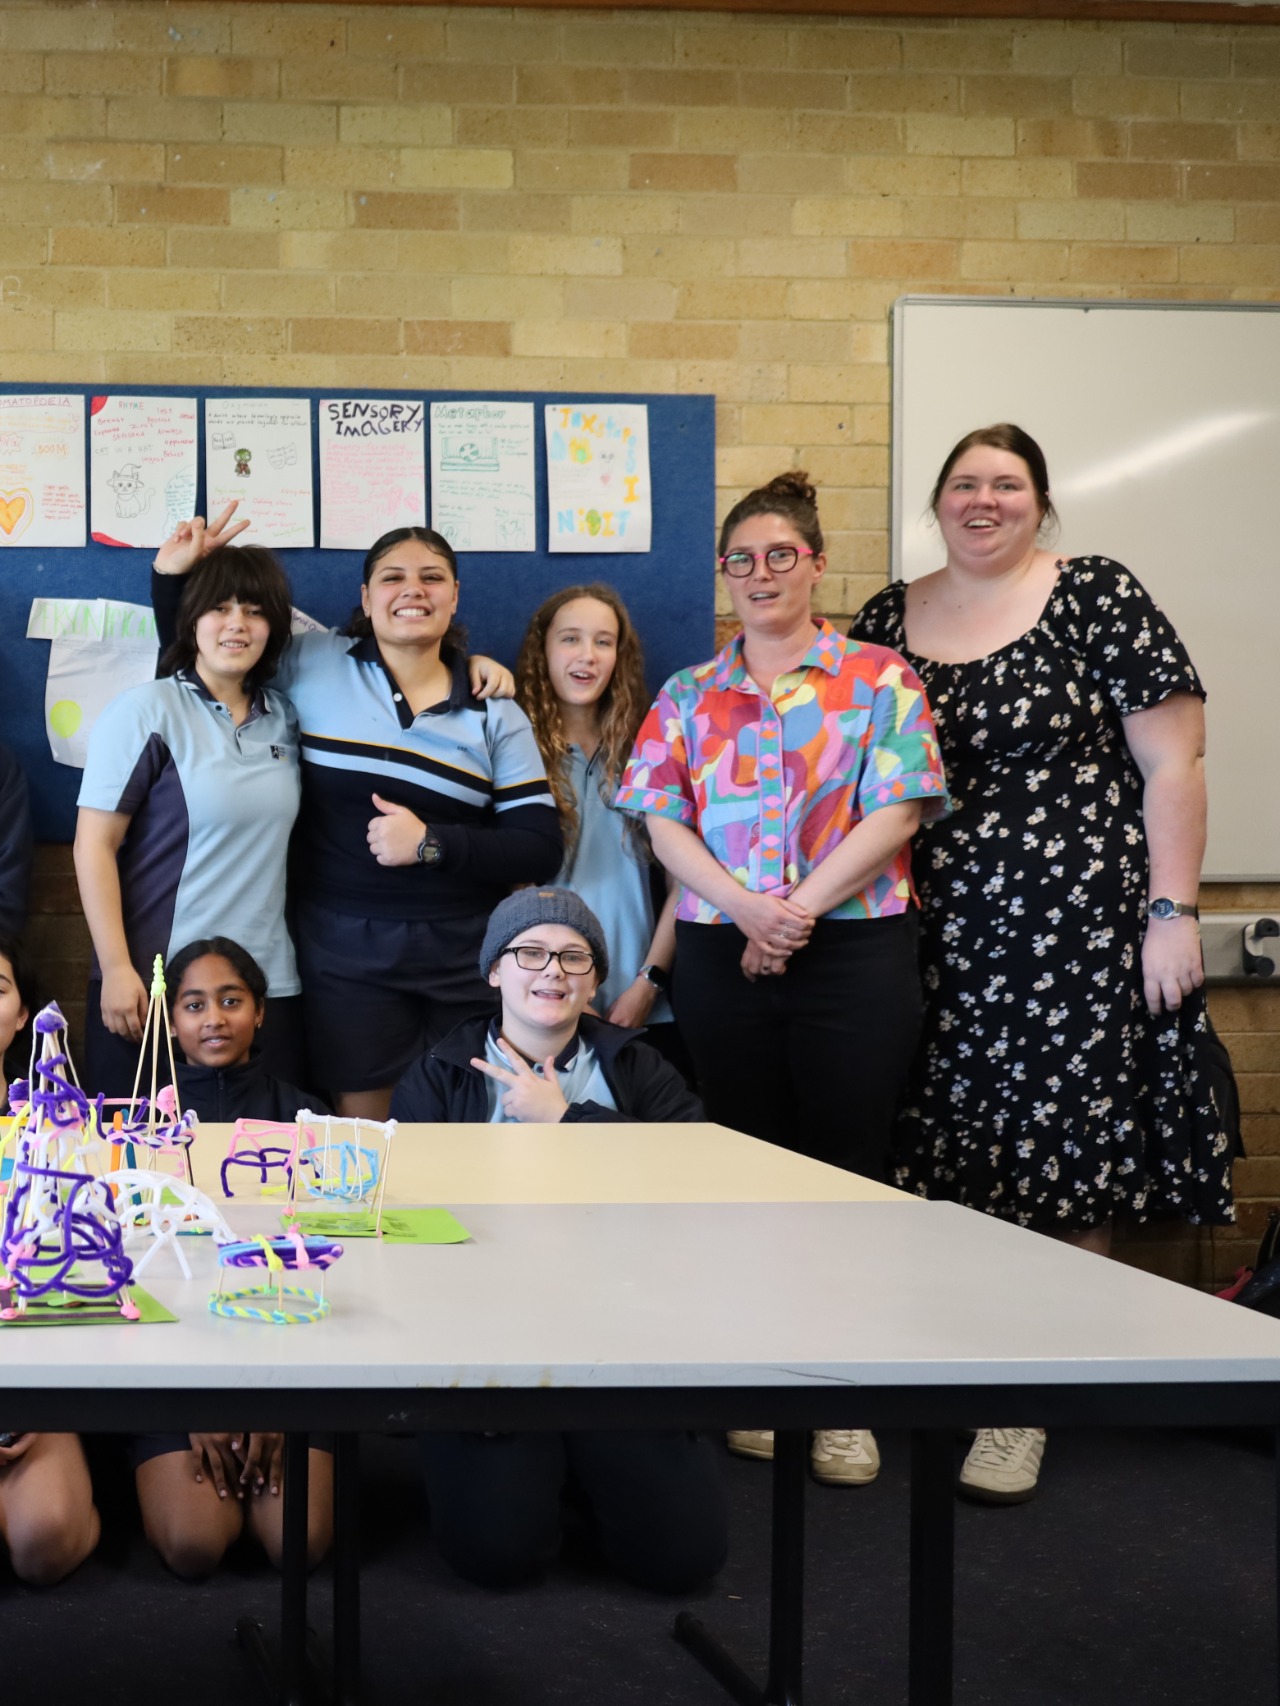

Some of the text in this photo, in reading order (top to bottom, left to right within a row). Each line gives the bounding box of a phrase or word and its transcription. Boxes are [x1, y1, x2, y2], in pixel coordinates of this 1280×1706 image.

[118, 400, 144, 410] RHYME
[328, 401, 421, 424] SENSORY
[434, 404, 506, 421] Metaphor
[336, 418, 425, 437] IMAGERY
[38, 444, 66, 456] BOOM
